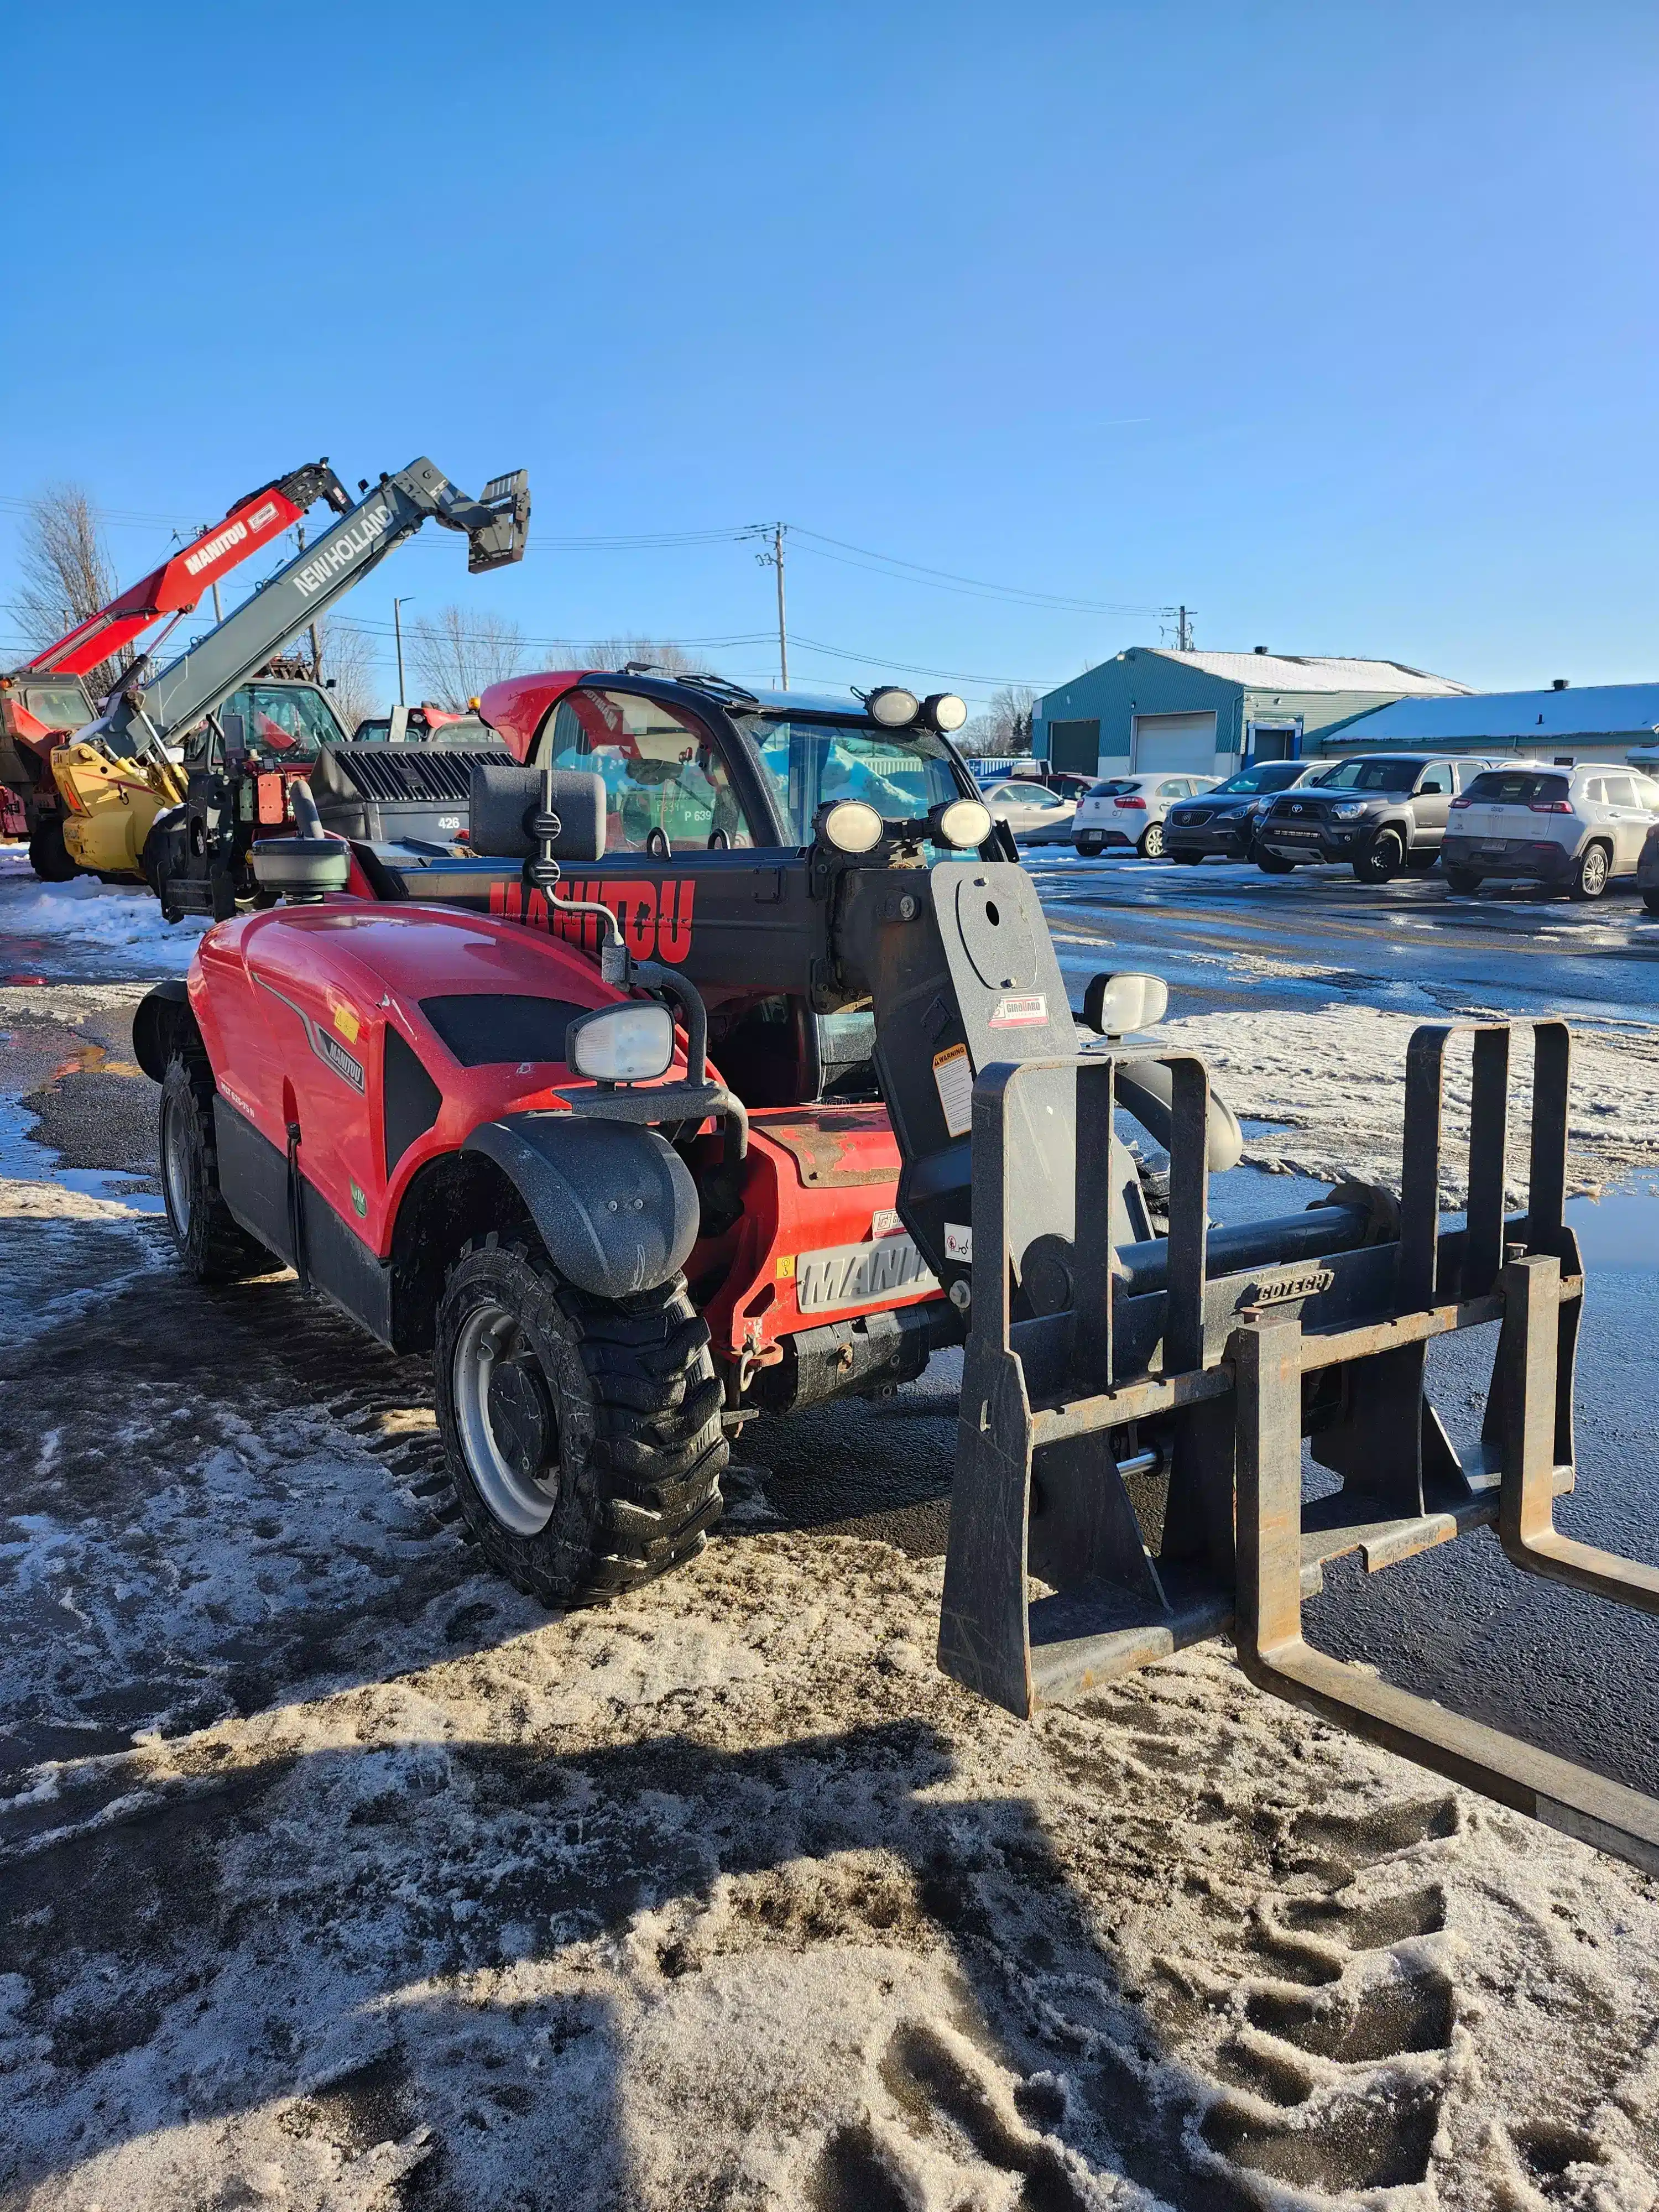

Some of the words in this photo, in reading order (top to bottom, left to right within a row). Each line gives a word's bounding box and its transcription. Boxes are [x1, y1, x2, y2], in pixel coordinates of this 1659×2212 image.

[184, 521, 247, 576] MANITOU
[293, 556, 333, 597] NEW
[323, 505, 394, 571] HOLLAND
[437, 817, 460, 829] 426
[685, 811, 692, 821] P
[694, 810, 712, 821] 639
[330, 1041, 361, 1082] MANITOU
[939, 1046, 964, 1063] WARNING
